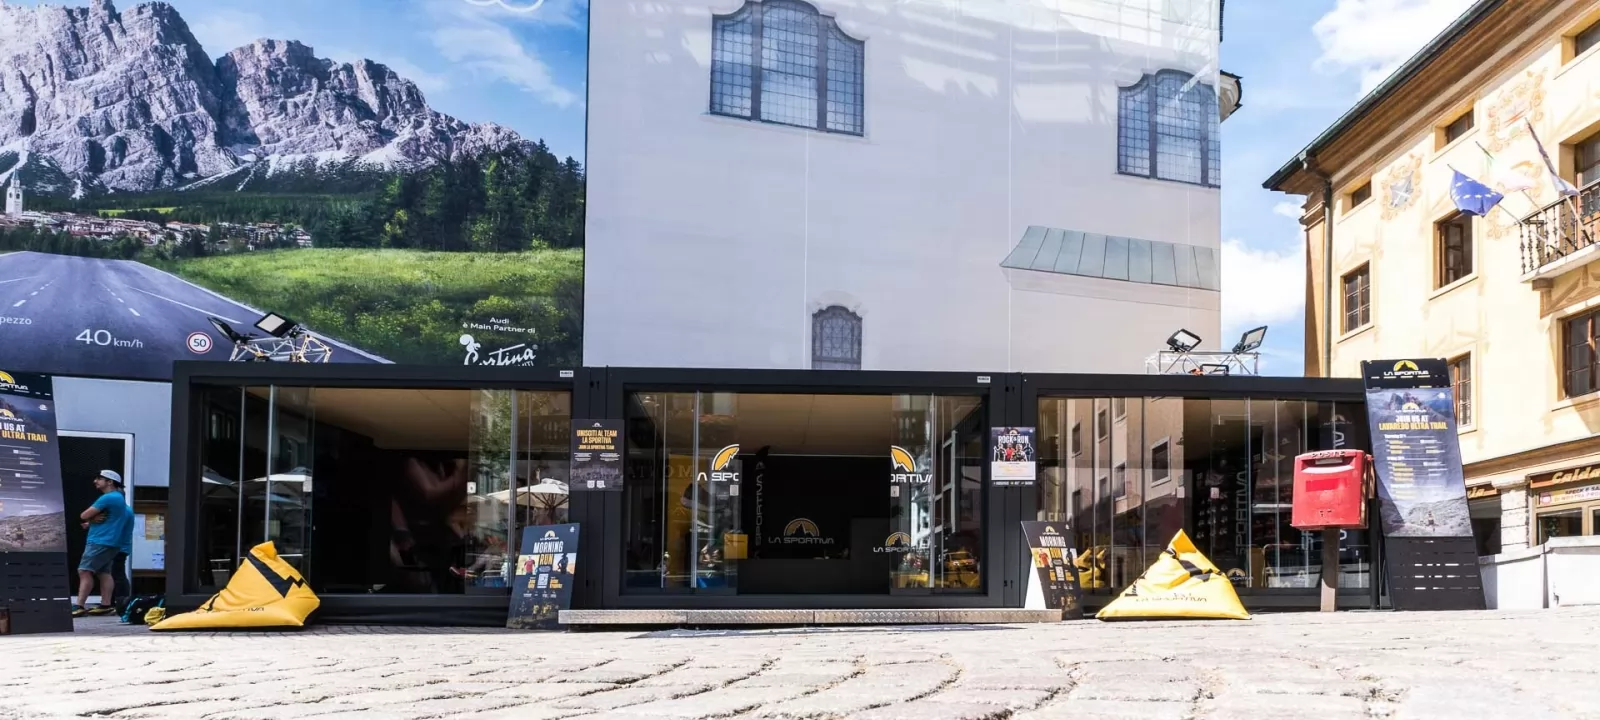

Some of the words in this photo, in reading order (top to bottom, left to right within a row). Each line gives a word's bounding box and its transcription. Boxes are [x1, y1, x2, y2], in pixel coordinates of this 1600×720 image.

[493, 324, 526, 333] Partner
[75, 329, 112, 346] 40
[113, 337, 144, 349] km/h
[193, 338, 207, 348] 50
[3, 422, 15, 431] US
[16, 424, 26, 432] AT
[1410, 422, 1430, 430] ULTRA
[1430, 421, 1449, 430] TRAIL
[2, 430, 26, 440] ULTRA
[26, 432, 48, 443] TRAIL
[581, 436, 588, 444] LA
[783, 537, 834, 545] SPORTIVA
[533, 541, 564, 553] MORNING
[539, 554, 554, 565] RUN
